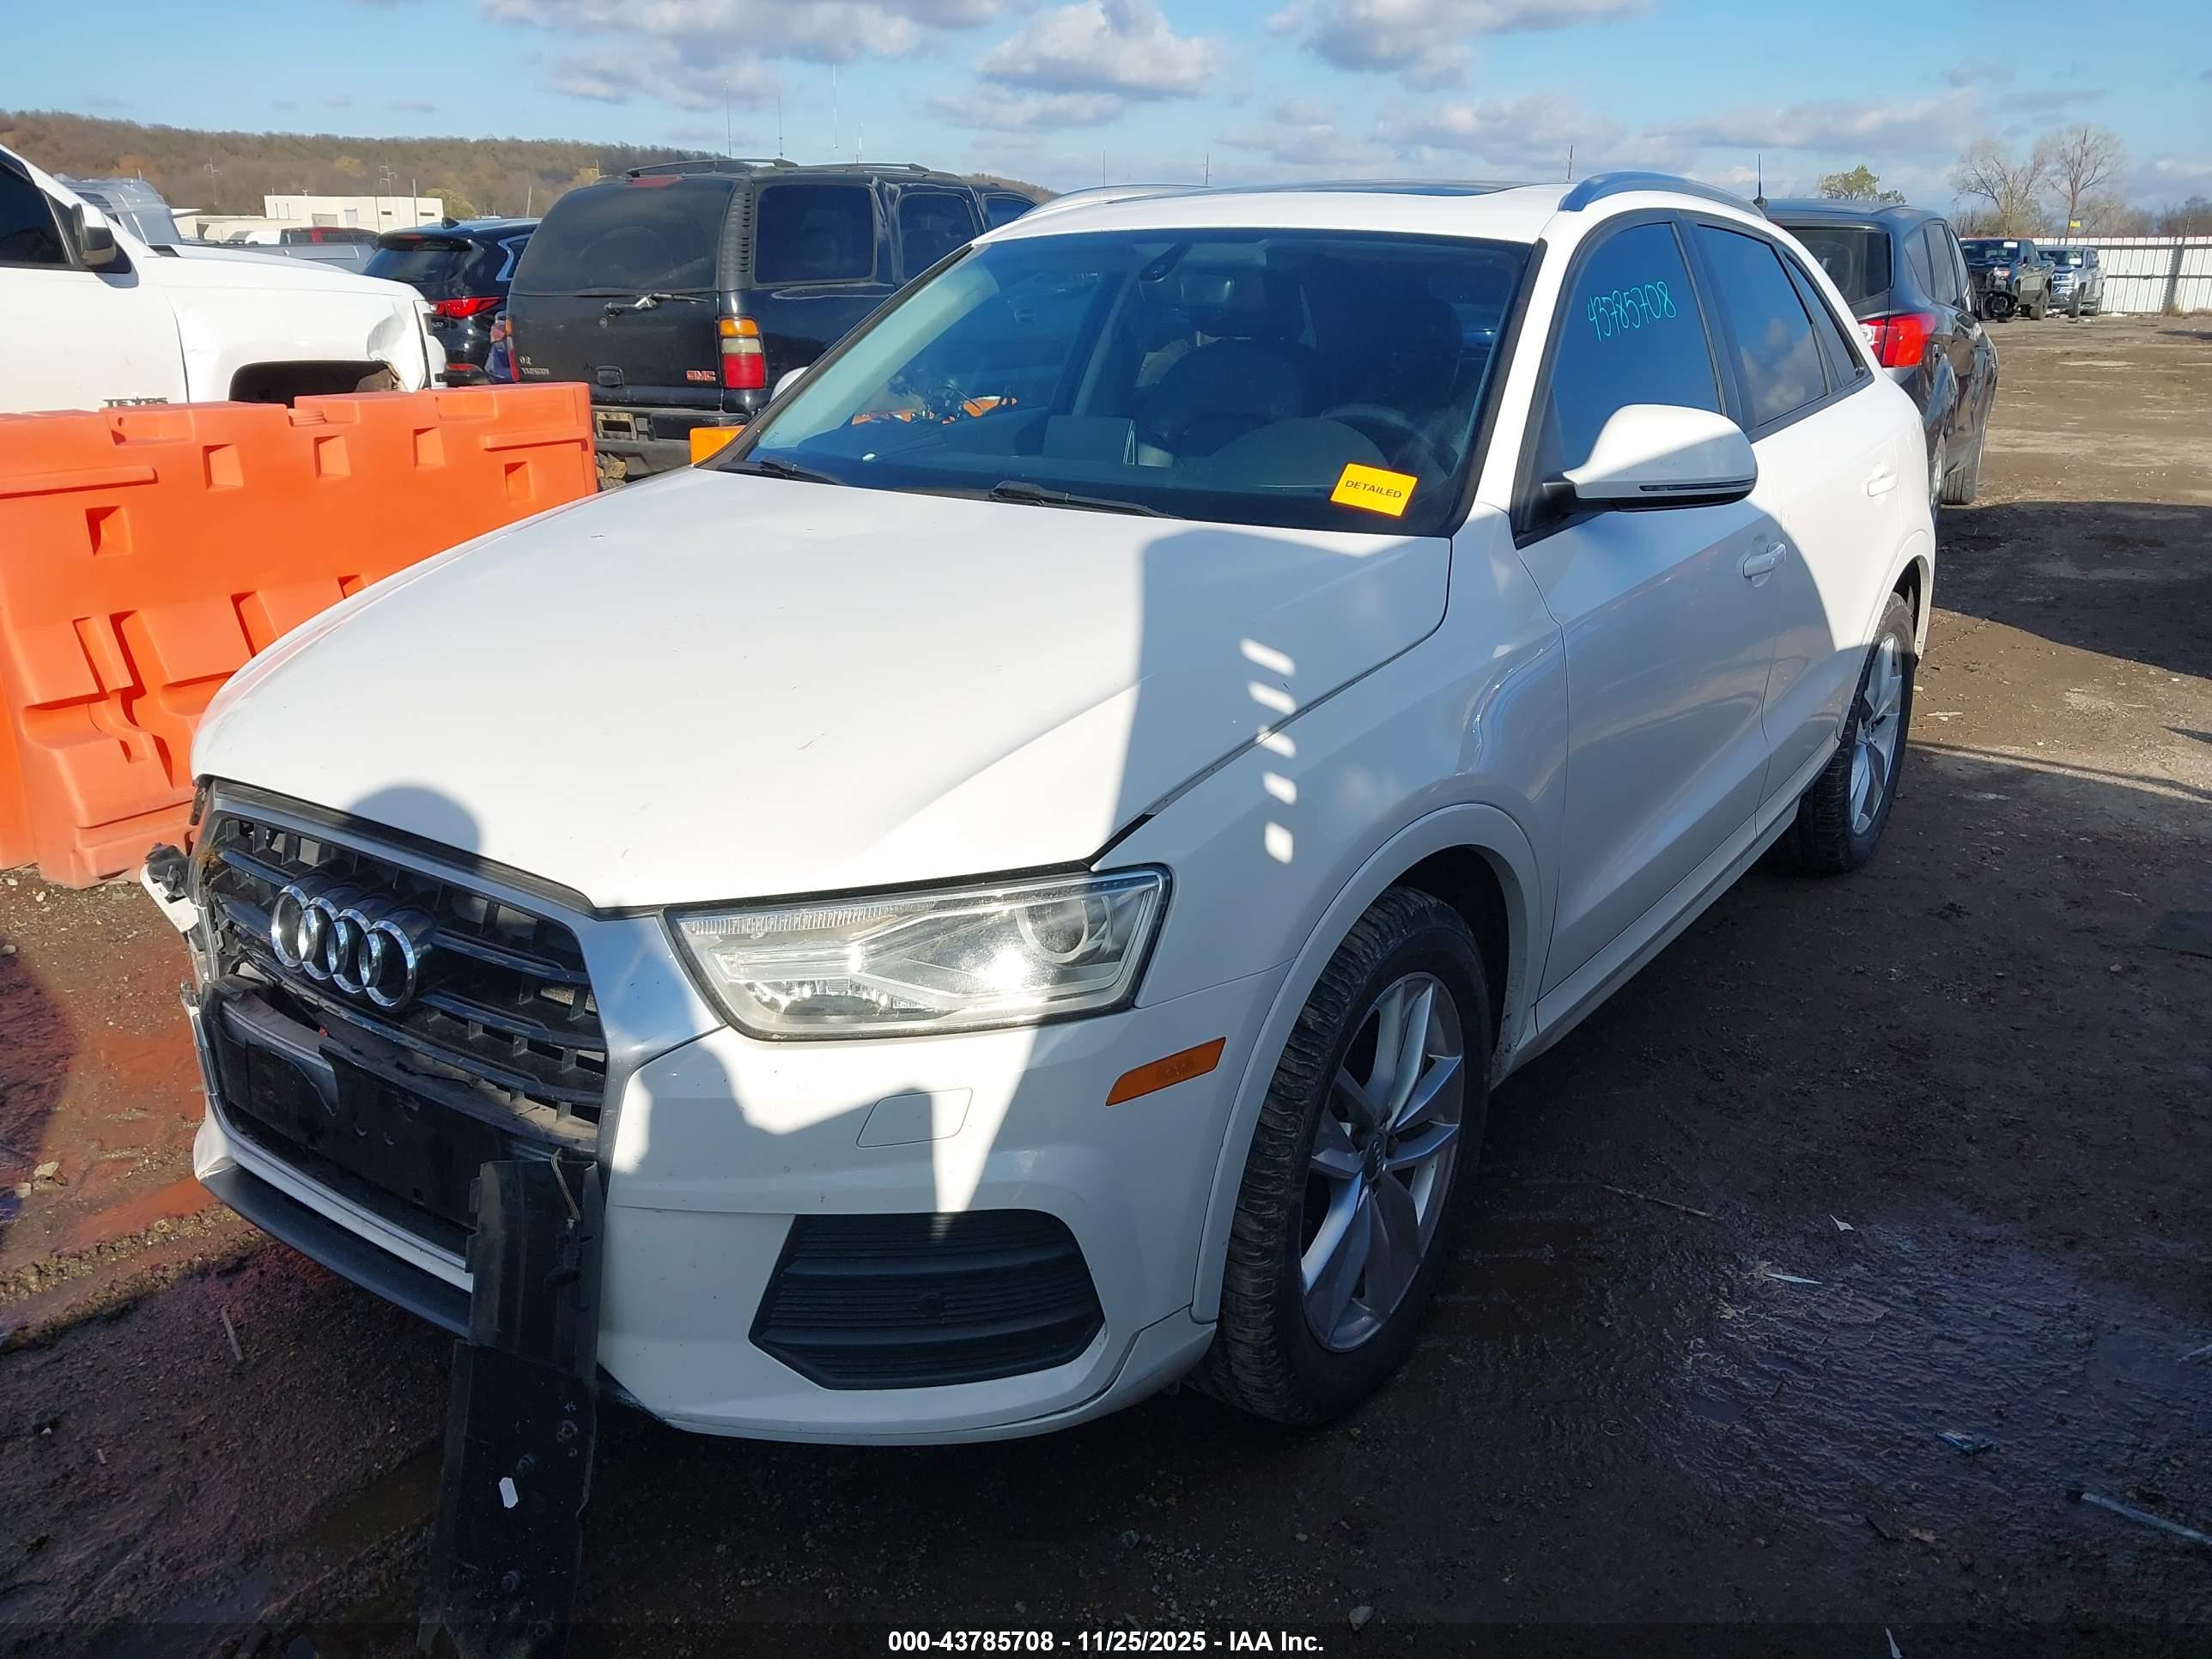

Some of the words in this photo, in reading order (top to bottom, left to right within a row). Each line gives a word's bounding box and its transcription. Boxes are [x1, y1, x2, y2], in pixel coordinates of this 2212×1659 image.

[1587, 281, 1677, 343] 43785708
[686, 369, 717, 381] GMC
[1345, 480, 1402, 498] DETAILED
